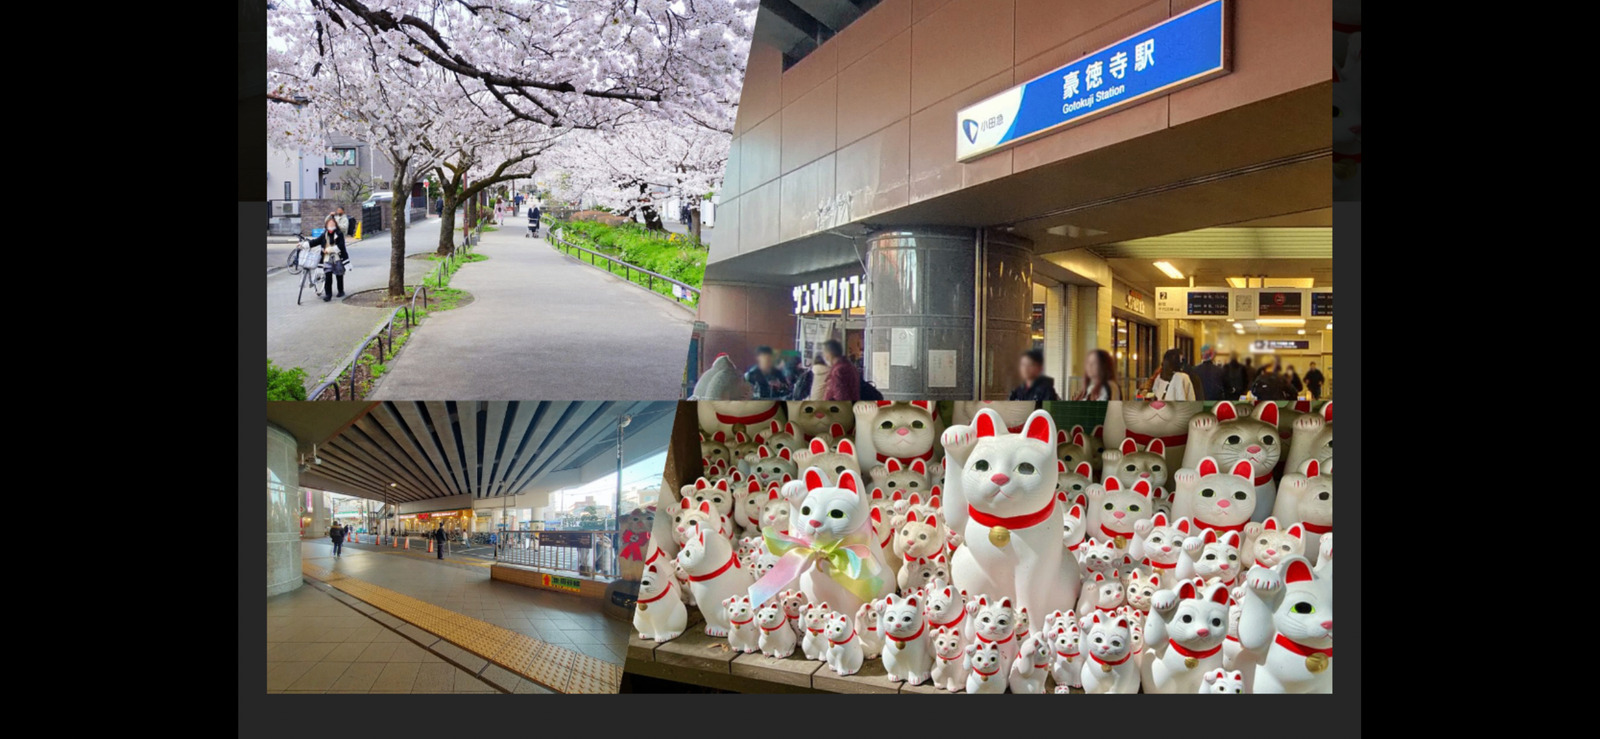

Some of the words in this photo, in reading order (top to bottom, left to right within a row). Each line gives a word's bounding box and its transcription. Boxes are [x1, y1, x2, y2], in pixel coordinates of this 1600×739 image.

[1063, 38, 1154, 100] 豪徳寺駅
[1063, 94, 1094, 114] Gotokuji
[1096, 85, 1125, 102] Station
